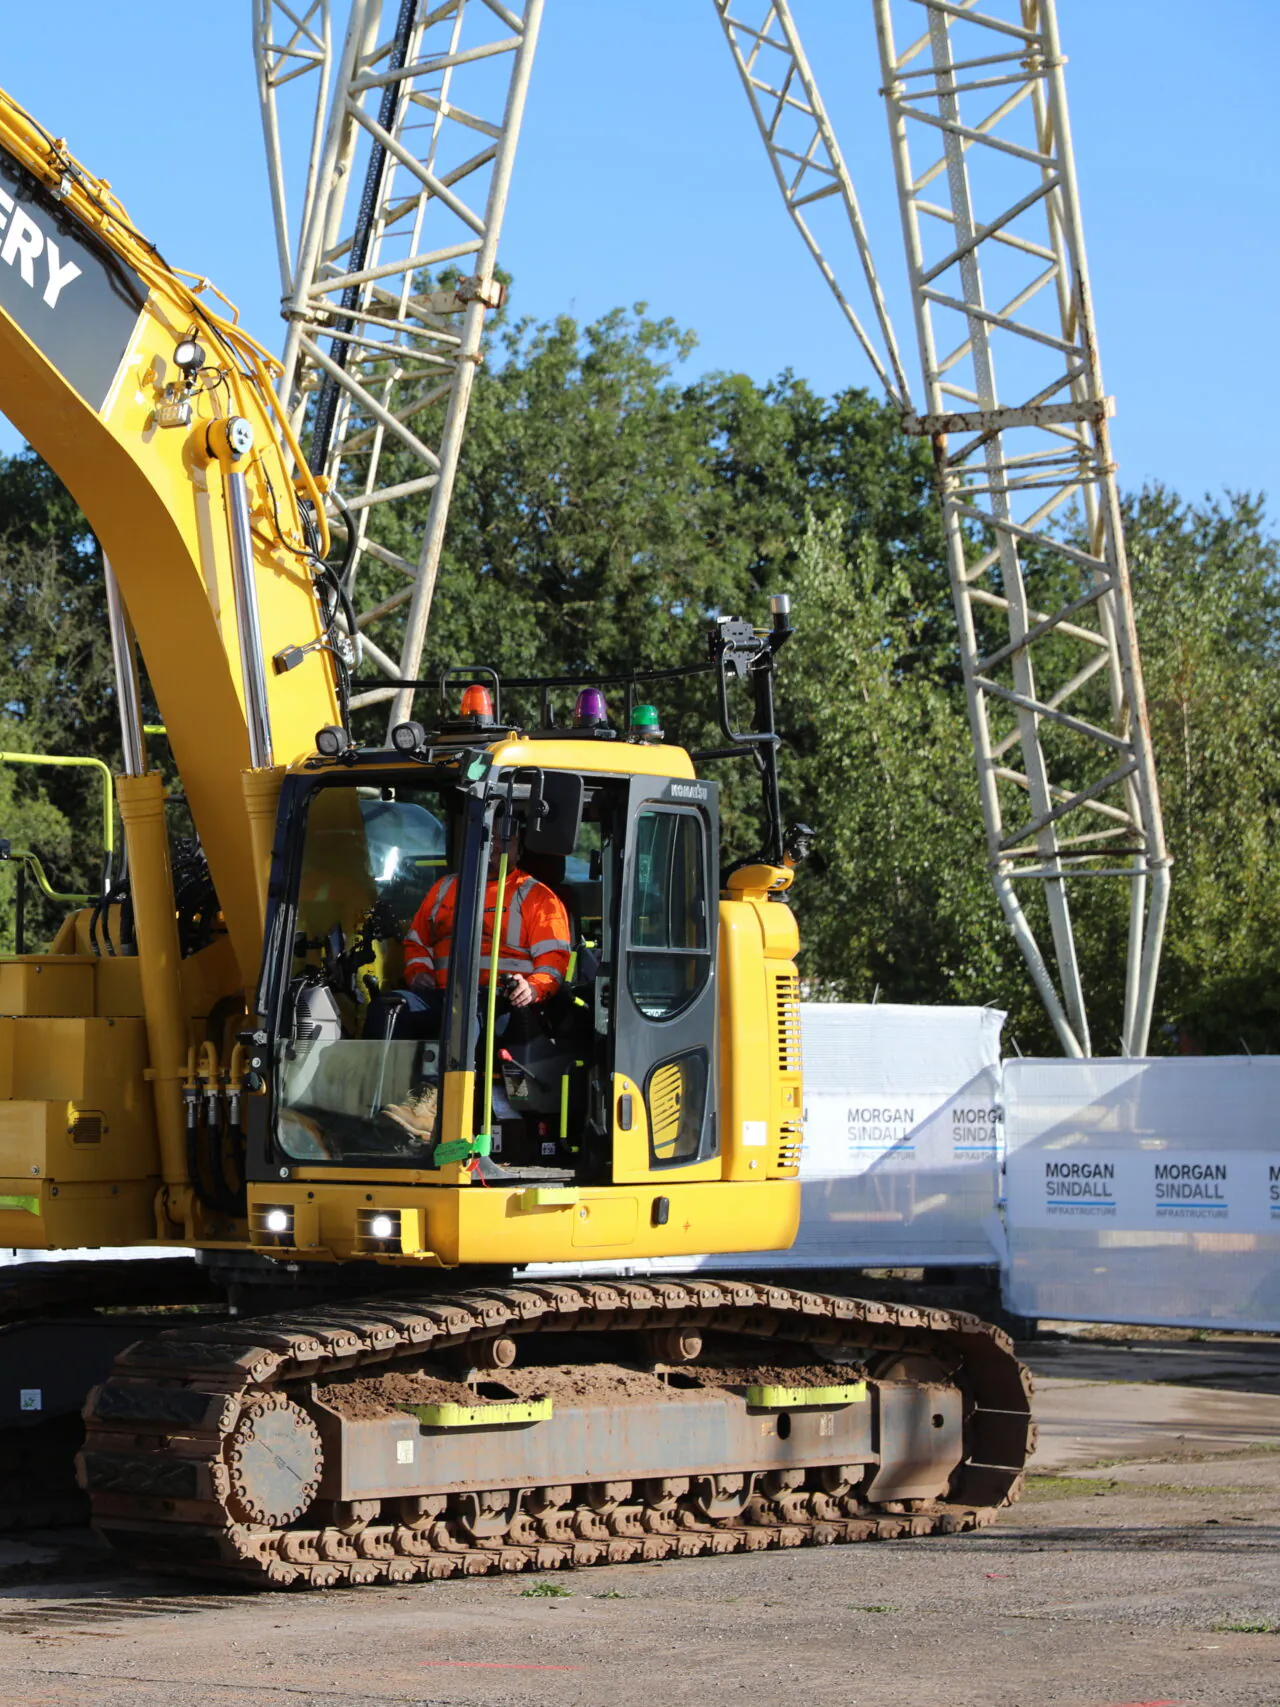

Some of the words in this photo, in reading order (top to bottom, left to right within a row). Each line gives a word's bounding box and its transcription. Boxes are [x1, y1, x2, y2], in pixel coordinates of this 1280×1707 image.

[847, 1107, 914, 1123] MORGAN
[847, 1126, 911, 1141] SINDALL
[1046, 1162, 1114, 1179] MORGAN
[1155, 1164, 1227, 1180] MORGAN
[1046, 1181, 1112, 1197] SINDALL
[1155, 1183, 1224, 1199] SINDALL
